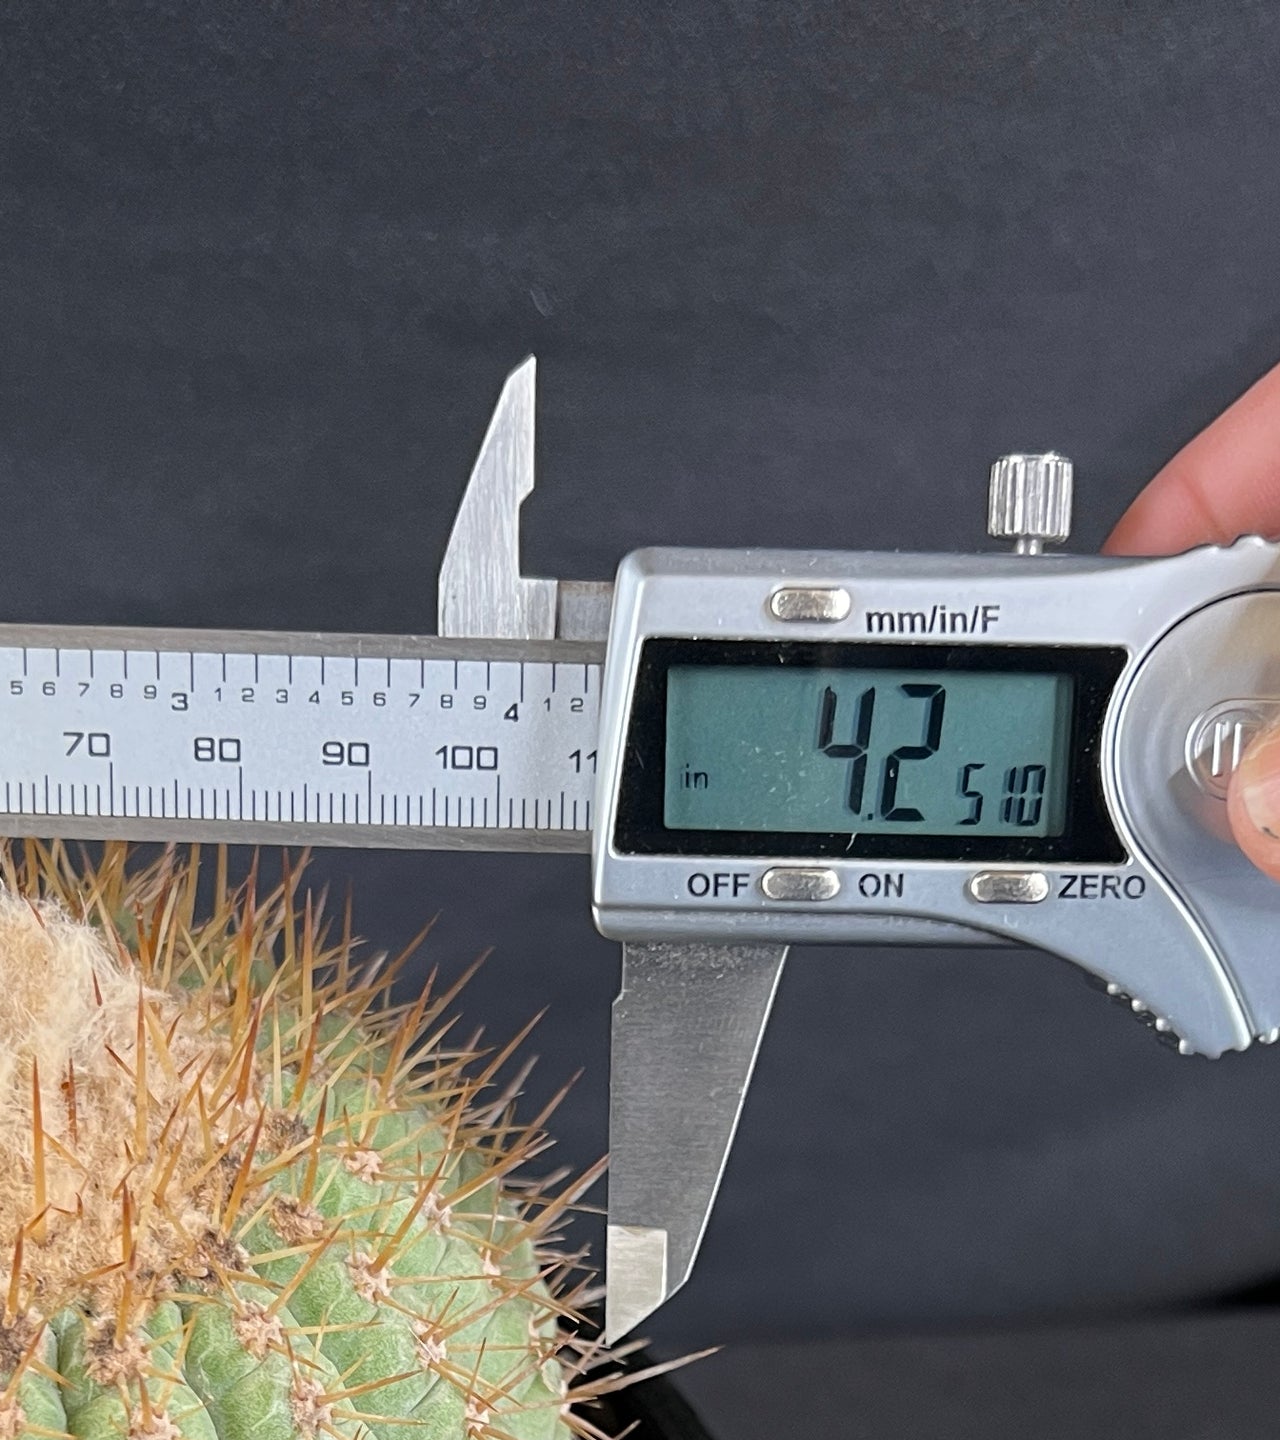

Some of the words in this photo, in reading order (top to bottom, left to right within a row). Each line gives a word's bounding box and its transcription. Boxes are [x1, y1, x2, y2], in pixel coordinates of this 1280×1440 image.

[865, 604, 1001, 635] mm/in/F
[9, 680, 24, 696] 5
[42, 681, 56, 697] 6
[77, 681, 91, 698] 7
[109, 683, 124, 699] 8
[143, 684, 158, 700] 9
[170, 691, 189, 712] 3
[214, 687, 222, 703] 1
[241, 687, 255, 704] 2
[275, 688, 289, 704] 3
[308, 690, 321, 705] 4
[341, 690, 354, 706] 5
[372, 691, 387, 707] 6
[408, 692, 421, 708] 7
[440, 693, 454, 710] 8
[473, 694, 487, 711] 9
[503, 702, 520, 723] 4
[543, 696, 551, 713] 1
[570, 696, 584, 713] 2
[62, 731, 111, 758] 70
[193, 736, 242, 763] 80
[322, 740, 370, 768] 90
[434, 744, 499, 772] 100
[568, 748, 600, 776] 11
[682, 763, 709, 790] in
[687, 872, 750, 898] OFF
[858, 872, 904, 899] ON
[1058, 874, 1146, 900] ZERO
